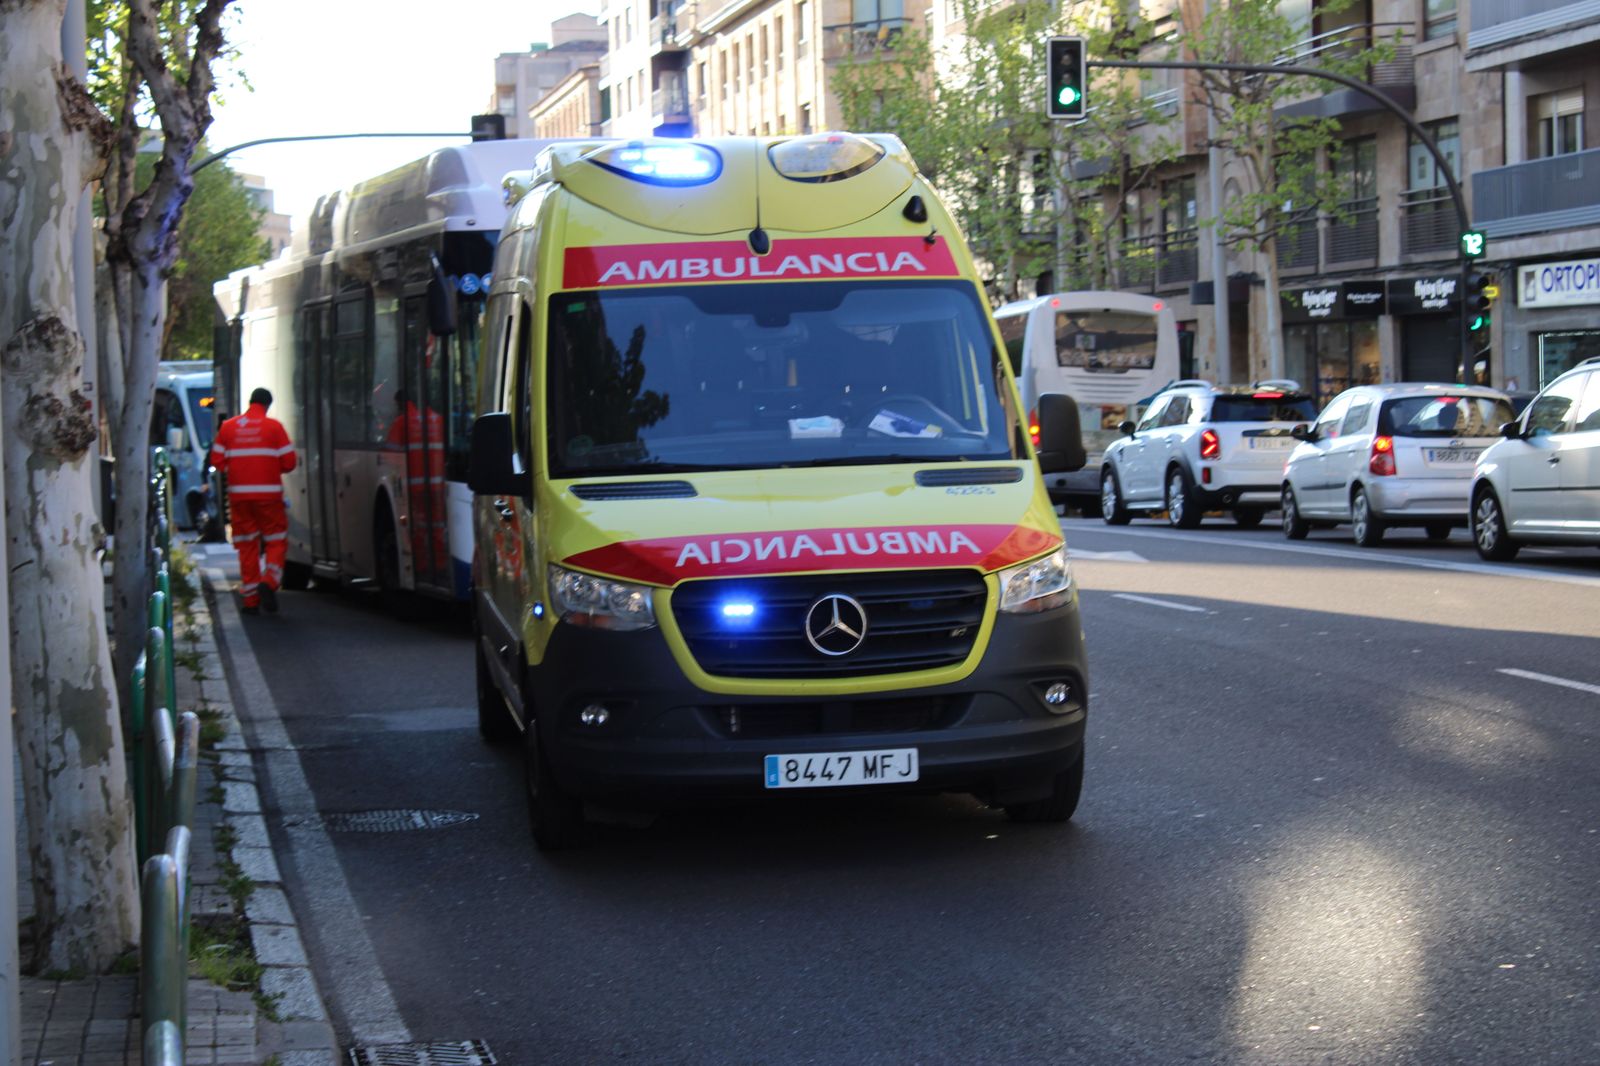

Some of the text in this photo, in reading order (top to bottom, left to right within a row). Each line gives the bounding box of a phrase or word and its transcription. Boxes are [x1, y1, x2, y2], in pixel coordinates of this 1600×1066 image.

[1462, 233, 1483, 255] 12
[597, 251, 928, 283] AMBULANCIA
[785, 753, 912, 783] 8447 MFJ
